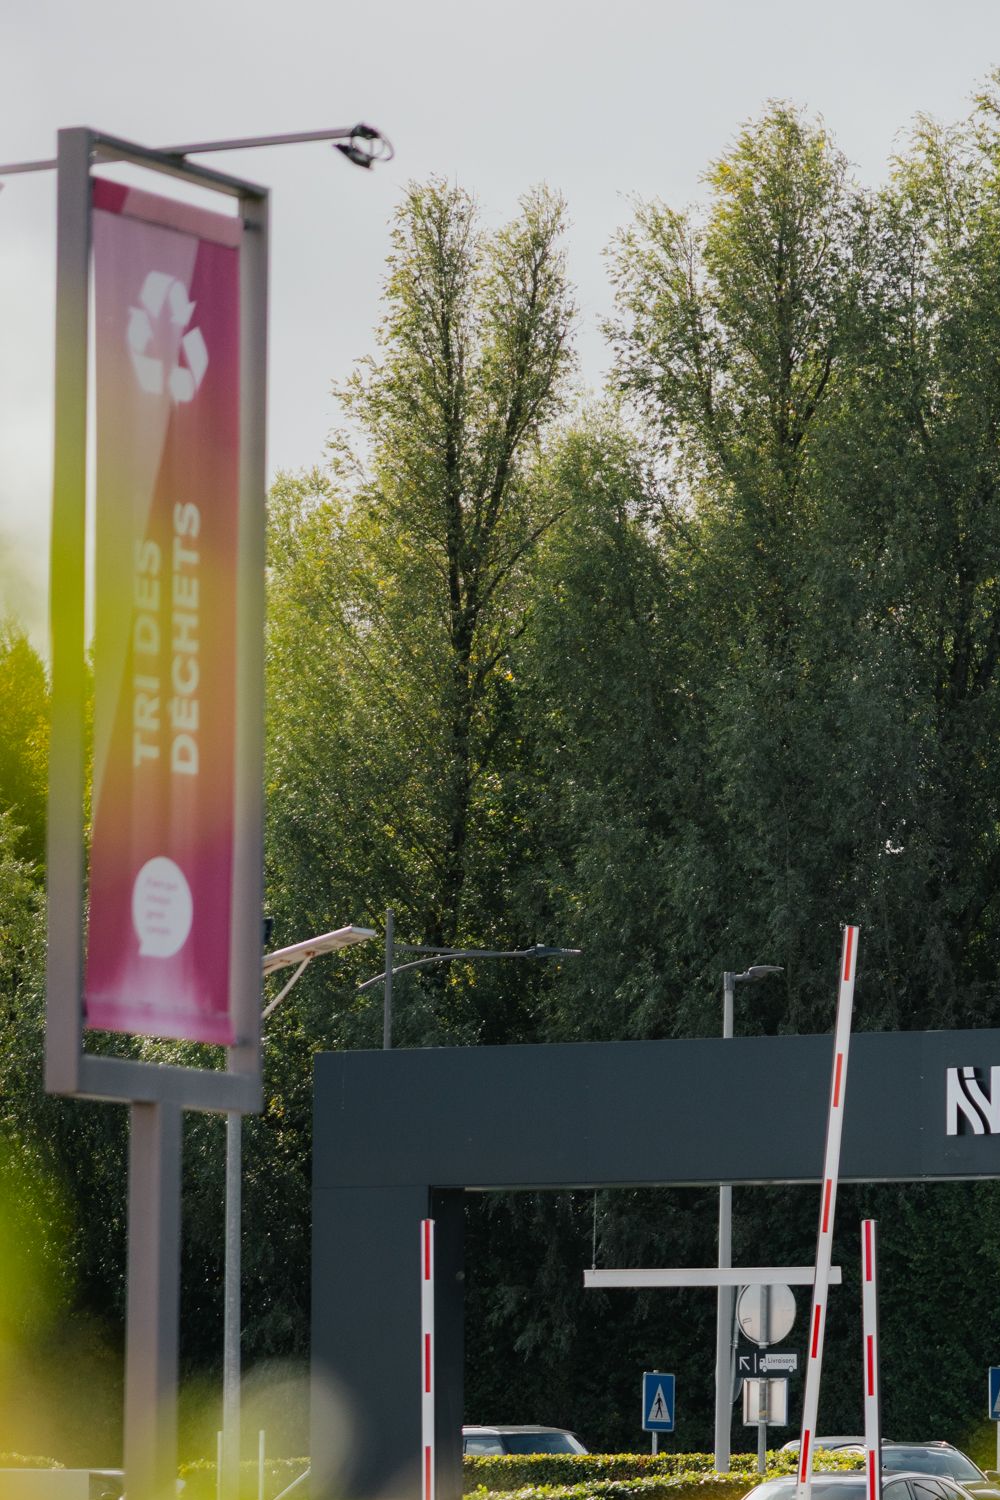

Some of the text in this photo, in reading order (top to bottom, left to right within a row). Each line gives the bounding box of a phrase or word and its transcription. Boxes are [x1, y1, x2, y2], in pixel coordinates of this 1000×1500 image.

[133, 538, 162, 769] TRI DES
[169, 501, 201, 776] DÉCHETS
